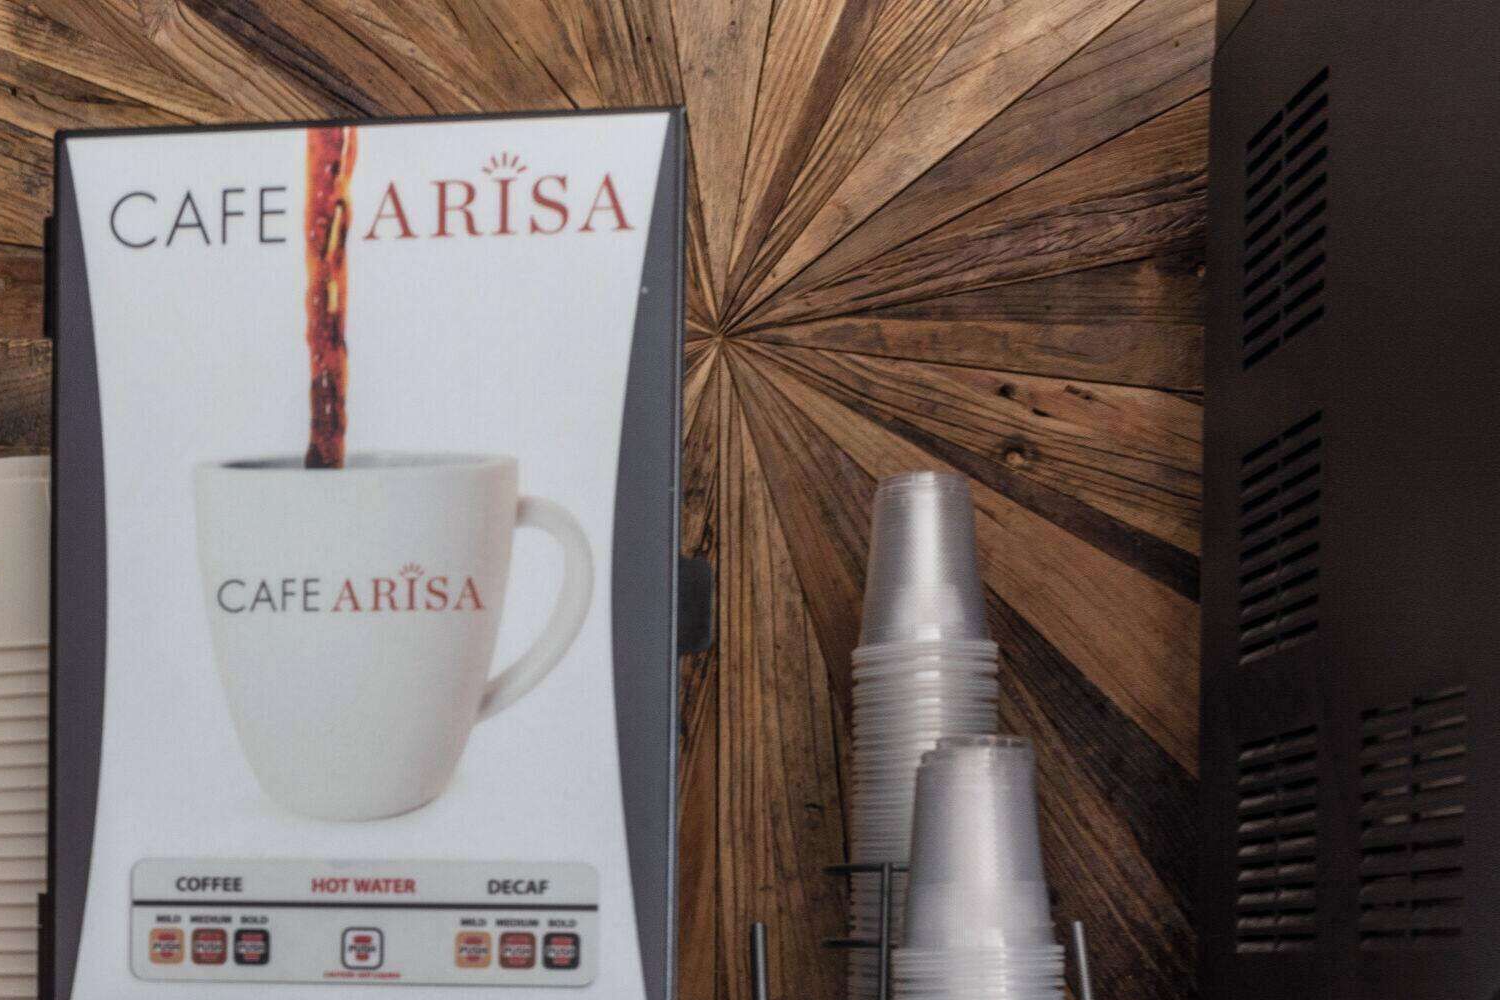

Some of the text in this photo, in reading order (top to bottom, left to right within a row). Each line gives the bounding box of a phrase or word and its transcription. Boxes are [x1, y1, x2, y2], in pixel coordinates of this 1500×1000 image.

[109, 170, 636, 249] CAFE ARISA
[217, 573, 486, 614] CAFE ARISA
[175, 876, 243, 892] COFFEE
[311, 878, 416, 894] HOT WATER
[487, 879, 550, 895] DECAF
